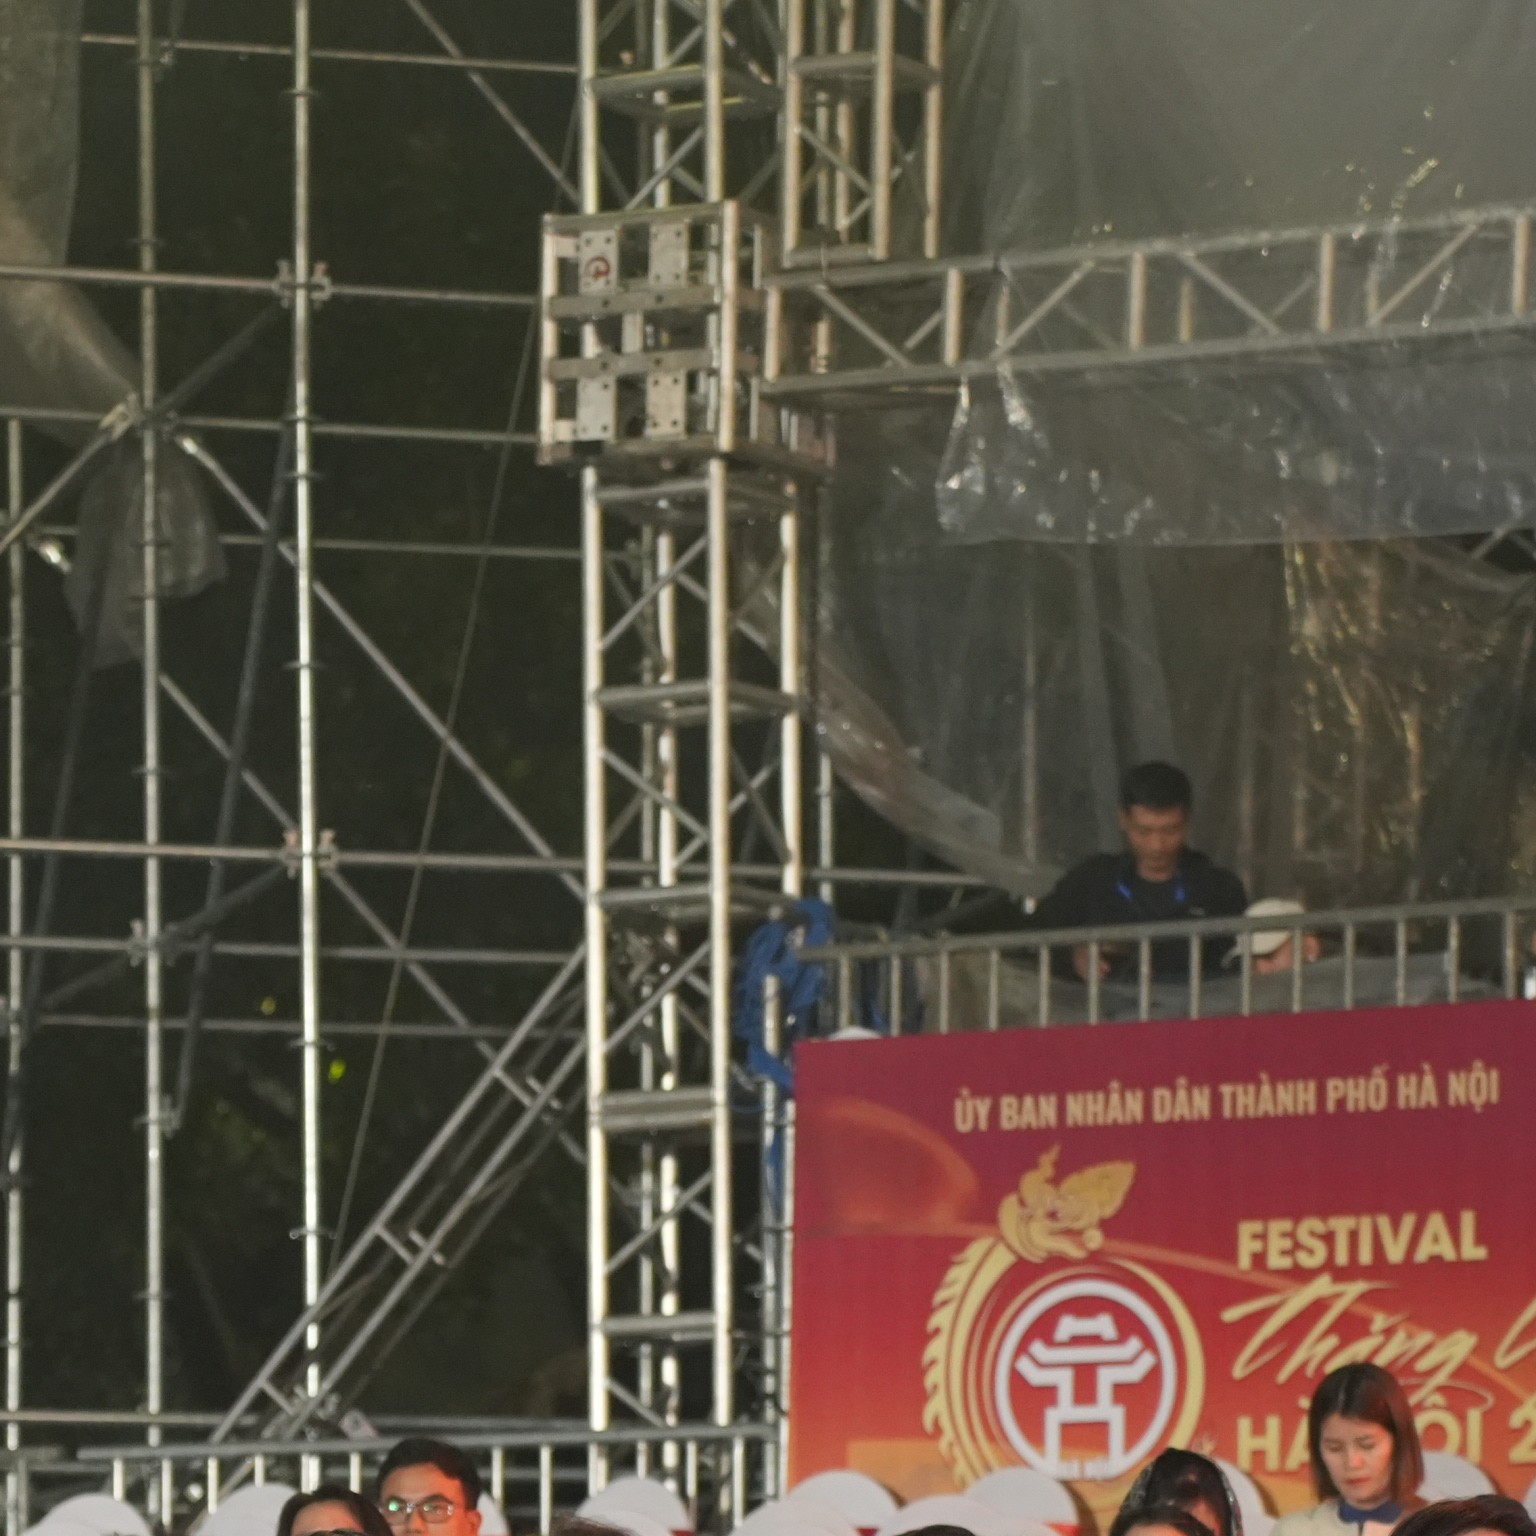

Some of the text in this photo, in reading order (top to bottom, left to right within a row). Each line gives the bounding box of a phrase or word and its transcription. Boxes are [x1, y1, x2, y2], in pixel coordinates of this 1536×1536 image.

[953, 1058, 1499, 1134] ỦY BAN NHÂN DÂN THÀNH PHỐ HÀ NỘI
[1237, 1209, 1489, 1272] FESTIVAL
[1220, 1272, 1478, 1406] Thăng
